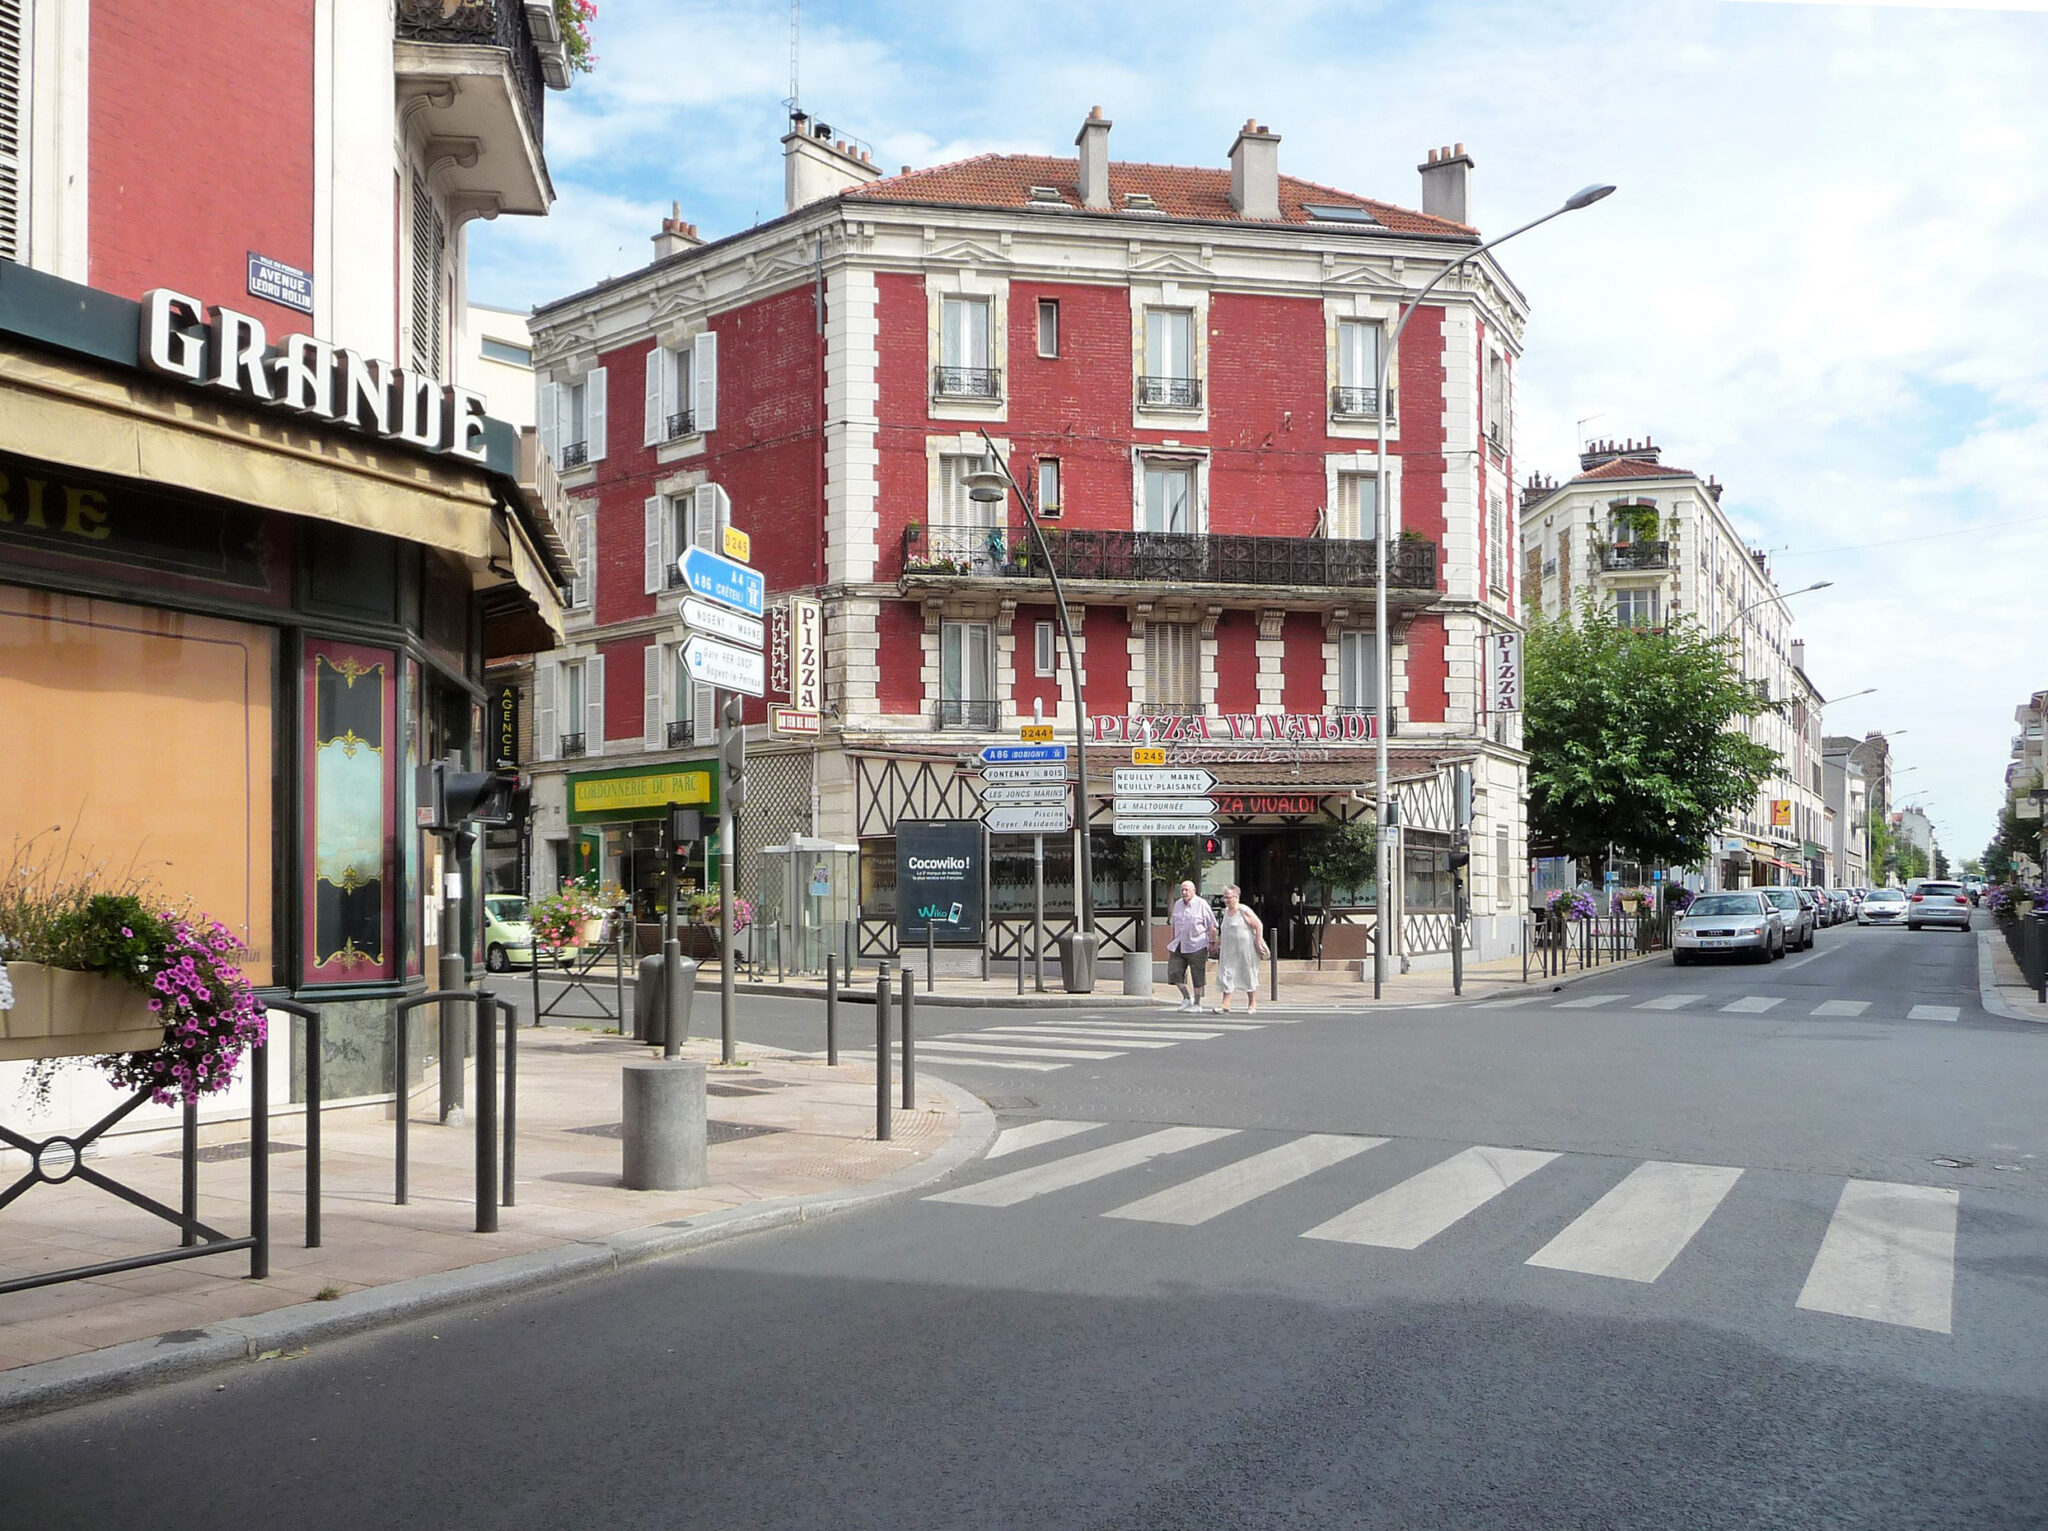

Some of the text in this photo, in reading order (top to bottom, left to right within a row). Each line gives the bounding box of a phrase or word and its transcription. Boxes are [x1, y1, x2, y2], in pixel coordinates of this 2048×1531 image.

[260, 266, 305, 292] AVENUE
[252, 277, 311, 308] LEDRU ROLLIN
[146, 287, 488, 462] GRANDE
[697, 610, 725, 628] NOGENT
[738, 624, 760, 641] MARNE
[801, 607, 815, 708] PIZZA
[1498, 634, 1515, 710] PIZZA
[502, 688, 512, 756] AGENCE
[1090, 714, 1212, 742] PIZZA
[988, 770, 1030, 778] FONTENAY
[578, 775, 698, 800] CORDONNERIE DU PARC
[1006, 790, 1030, 798] JONCS
[1033, 790, 1063, 798] MARINS
[1034, 810, 1063, 818] Piscine
[1250, 797, 1315, 812] VIVALDI
[996, 820, 1063, 830] Foyer Résidence
[918, 904, 948, 918] Wiko
